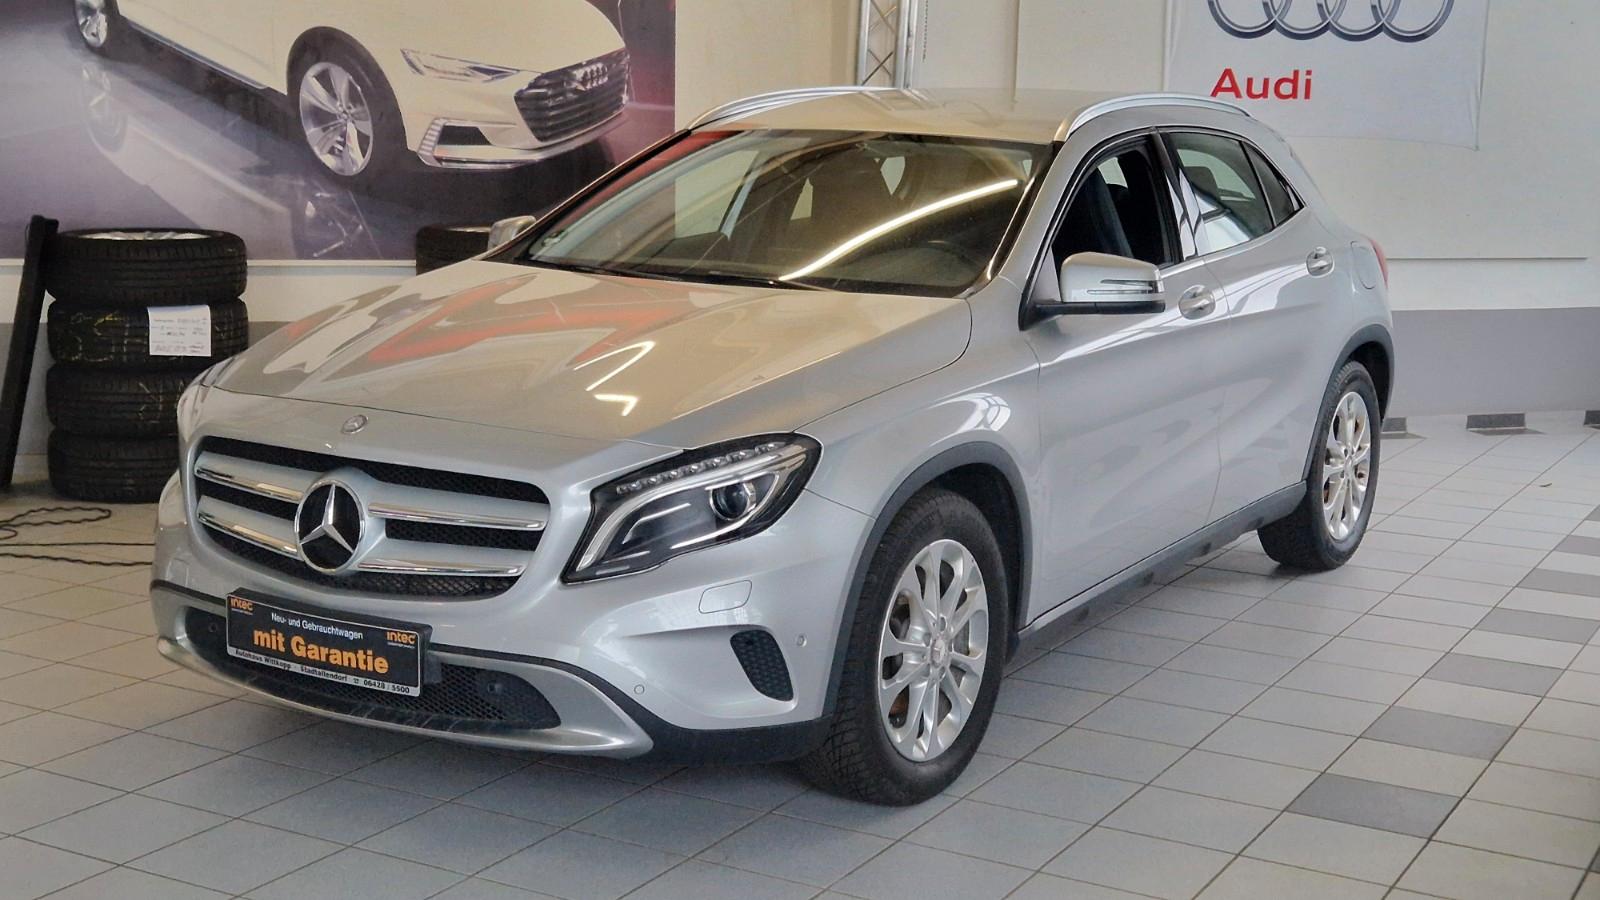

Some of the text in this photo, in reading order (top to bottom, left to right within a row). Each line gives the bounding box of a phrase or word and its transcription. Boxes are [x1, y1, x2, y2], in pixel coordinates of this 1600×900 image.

[1210, 68, 1313, 100] Audi
[230, 597, 253, 611] intec
[271, 612, 363, 641] Neu- und Gebrauchtwagen
[386, 631, 416, 645] intec
[253, 629, 389, 674] mit Garantie
[235, 649, 263, 662] Autohaus
[264, 656, 291, 671] Wittkopp
[300, 665, 348, 682] Stadtallendorf
[363, 679, 386, 690] 06428
[391, 684, 410, 694] 5500
